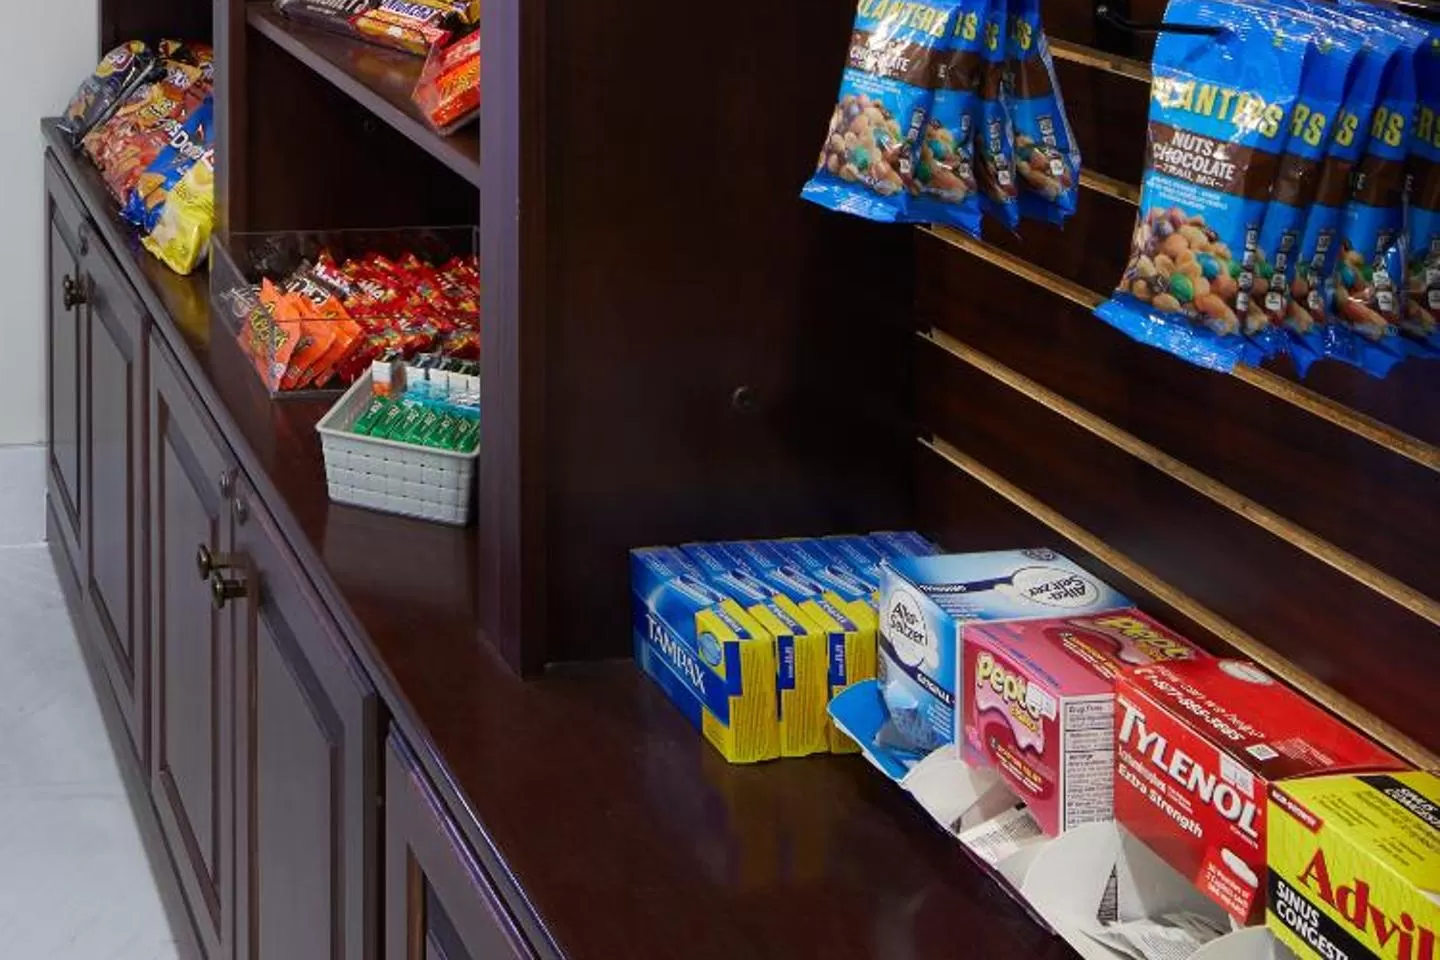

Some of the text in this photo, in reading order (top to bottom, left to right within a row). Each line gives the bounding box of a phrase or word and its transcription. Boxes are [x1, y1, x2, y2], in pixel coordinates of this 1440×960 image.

[1152, 142, 1237, 181] CHOCOLATE
[1171, 130, 1215, 157] NUTS
[646, 613, 706, 695] TAMPAX
[1116, 695, 1260, 839] TYLENOL
[1118, 762, 1148, 795] Extra
[1148, 787, 1203, 838] Strength
[1276, 899, 1349, 960] CONGEST
[1277, 880, 1321, 927] SINUS
[1296, 847, 1436, 960] Advil
